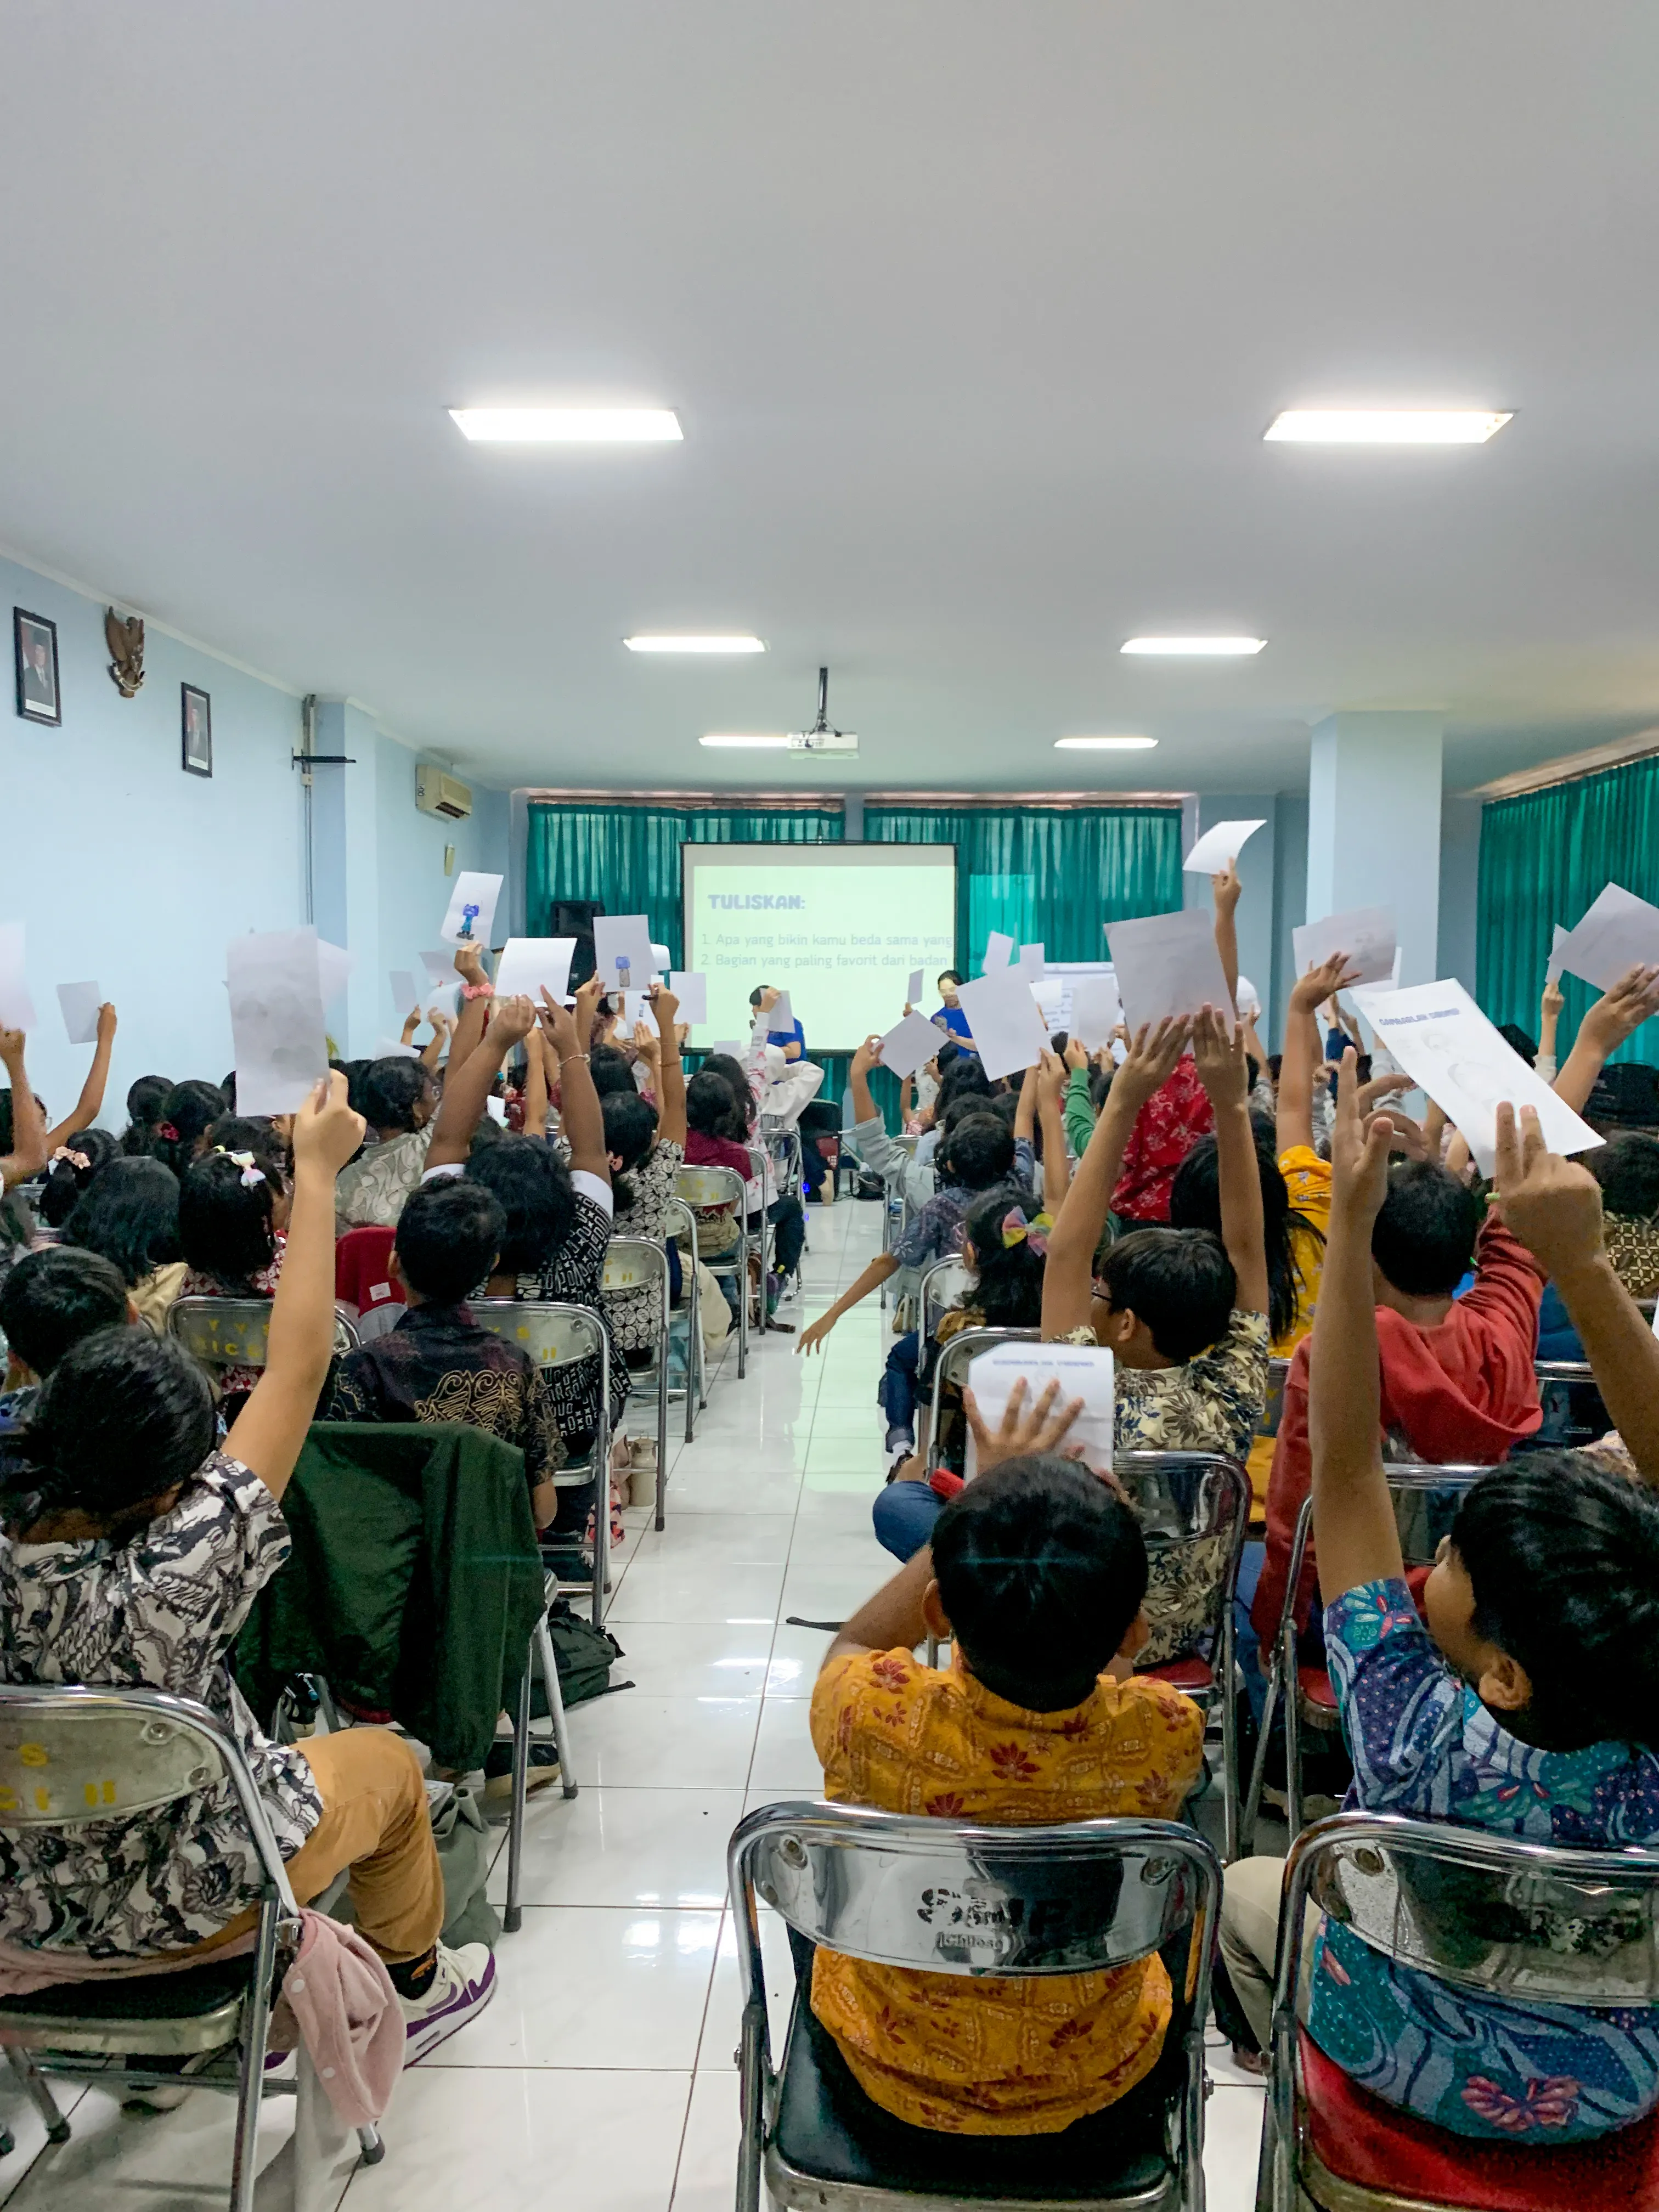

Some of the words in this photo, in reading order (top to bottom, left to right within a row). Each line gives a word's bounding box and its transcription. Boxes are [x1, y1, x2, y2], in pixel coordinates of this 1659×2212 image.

[708, 894, 805, 910] TULISKAN:
[716, 934, 740, 947] Apa
[744, 936, 774, 947] yang
[778, 934, 808, 945] bikin
[812, 934, 845, 945] kamu
[851, 934, 881, 945] beda
[886, 936, 918, 945] sama
[923, 936, 953, 948] yang
[715, 953, 756, 968] Bagian
[761, 957, 791, 968] yang
[795, 954, 832, 969] paling
[837, 954, 877, 966] favorit
[882, 955, 905, 966] dari
[910, 954, 947, 966] badan
